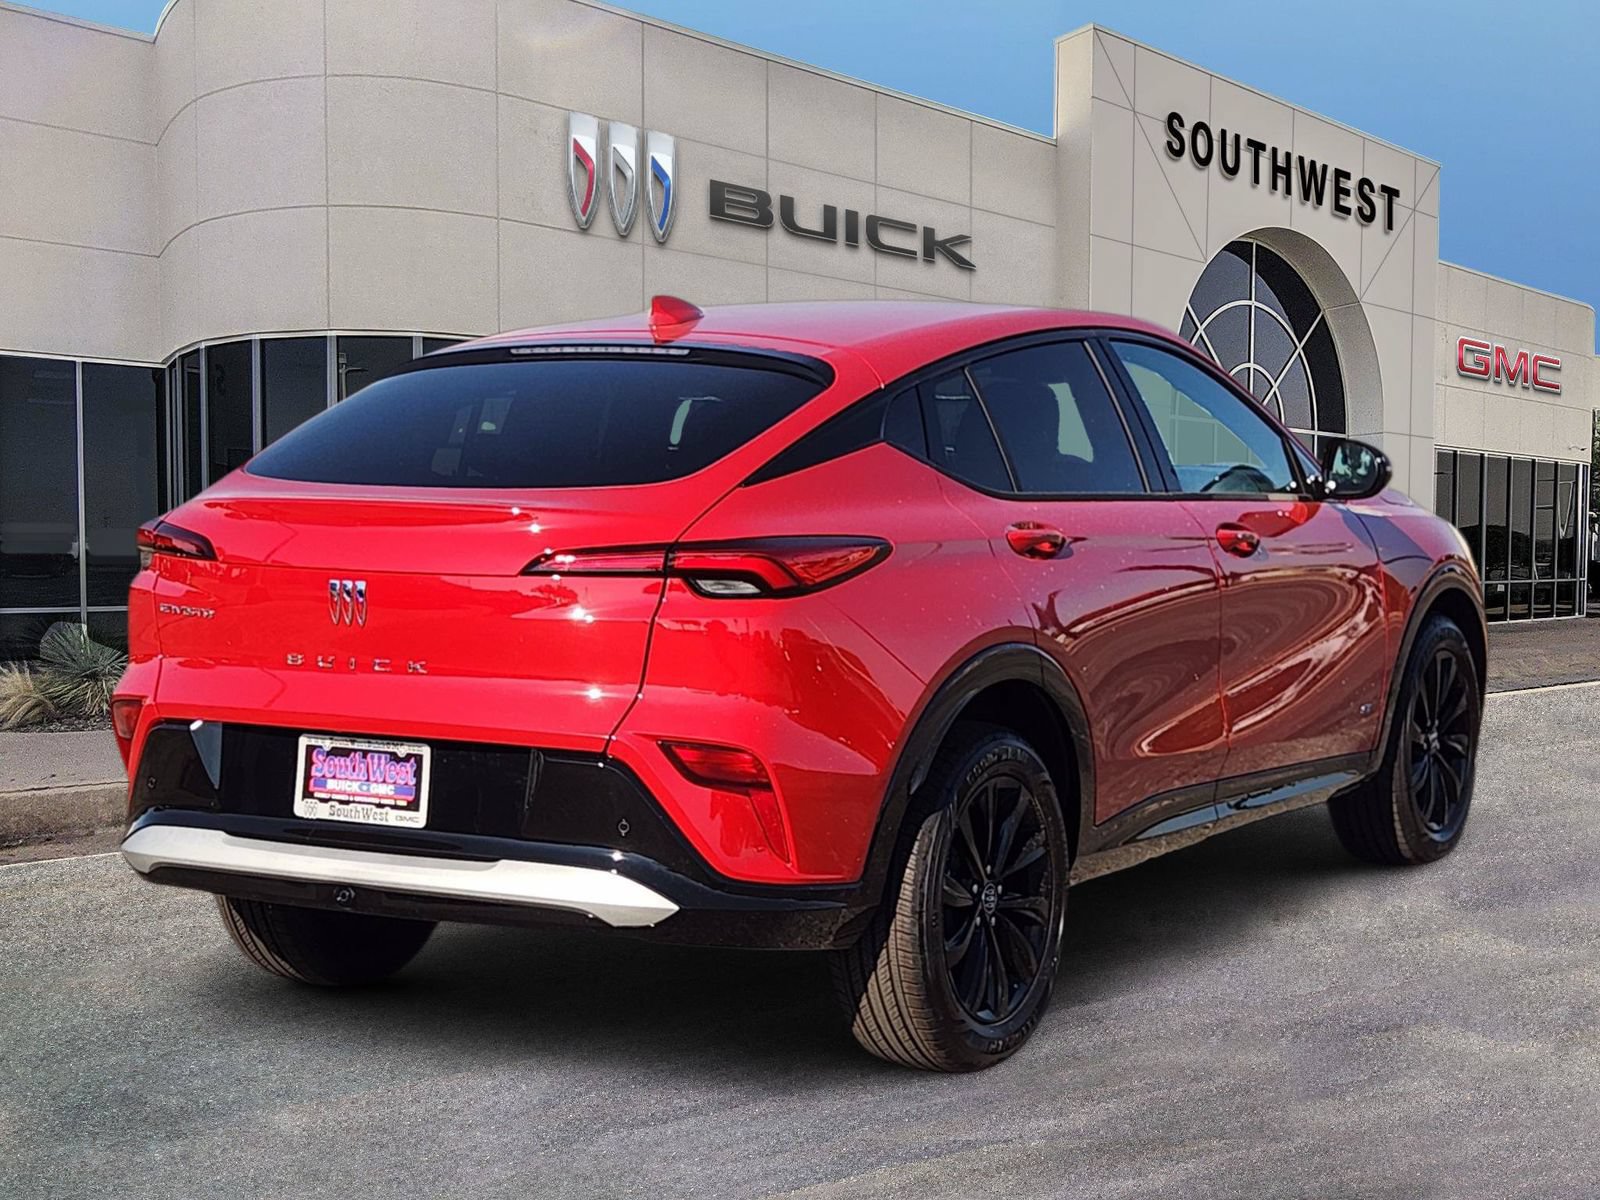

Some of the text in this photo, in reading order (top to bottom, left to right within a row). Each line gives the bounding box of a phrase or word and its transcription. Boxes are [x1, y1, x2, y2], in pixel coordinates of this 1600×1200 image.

[1165, 111, 1400, 232] SOUTHWEST
[709, 179, 977, 270] BUICK
[1457, 336, 1561, 394] GMC
[287, 653, 428, 674] BUICK
[311, 747, 417, 785] SouthWest
[328, 804, 390, 823] SouthWest
